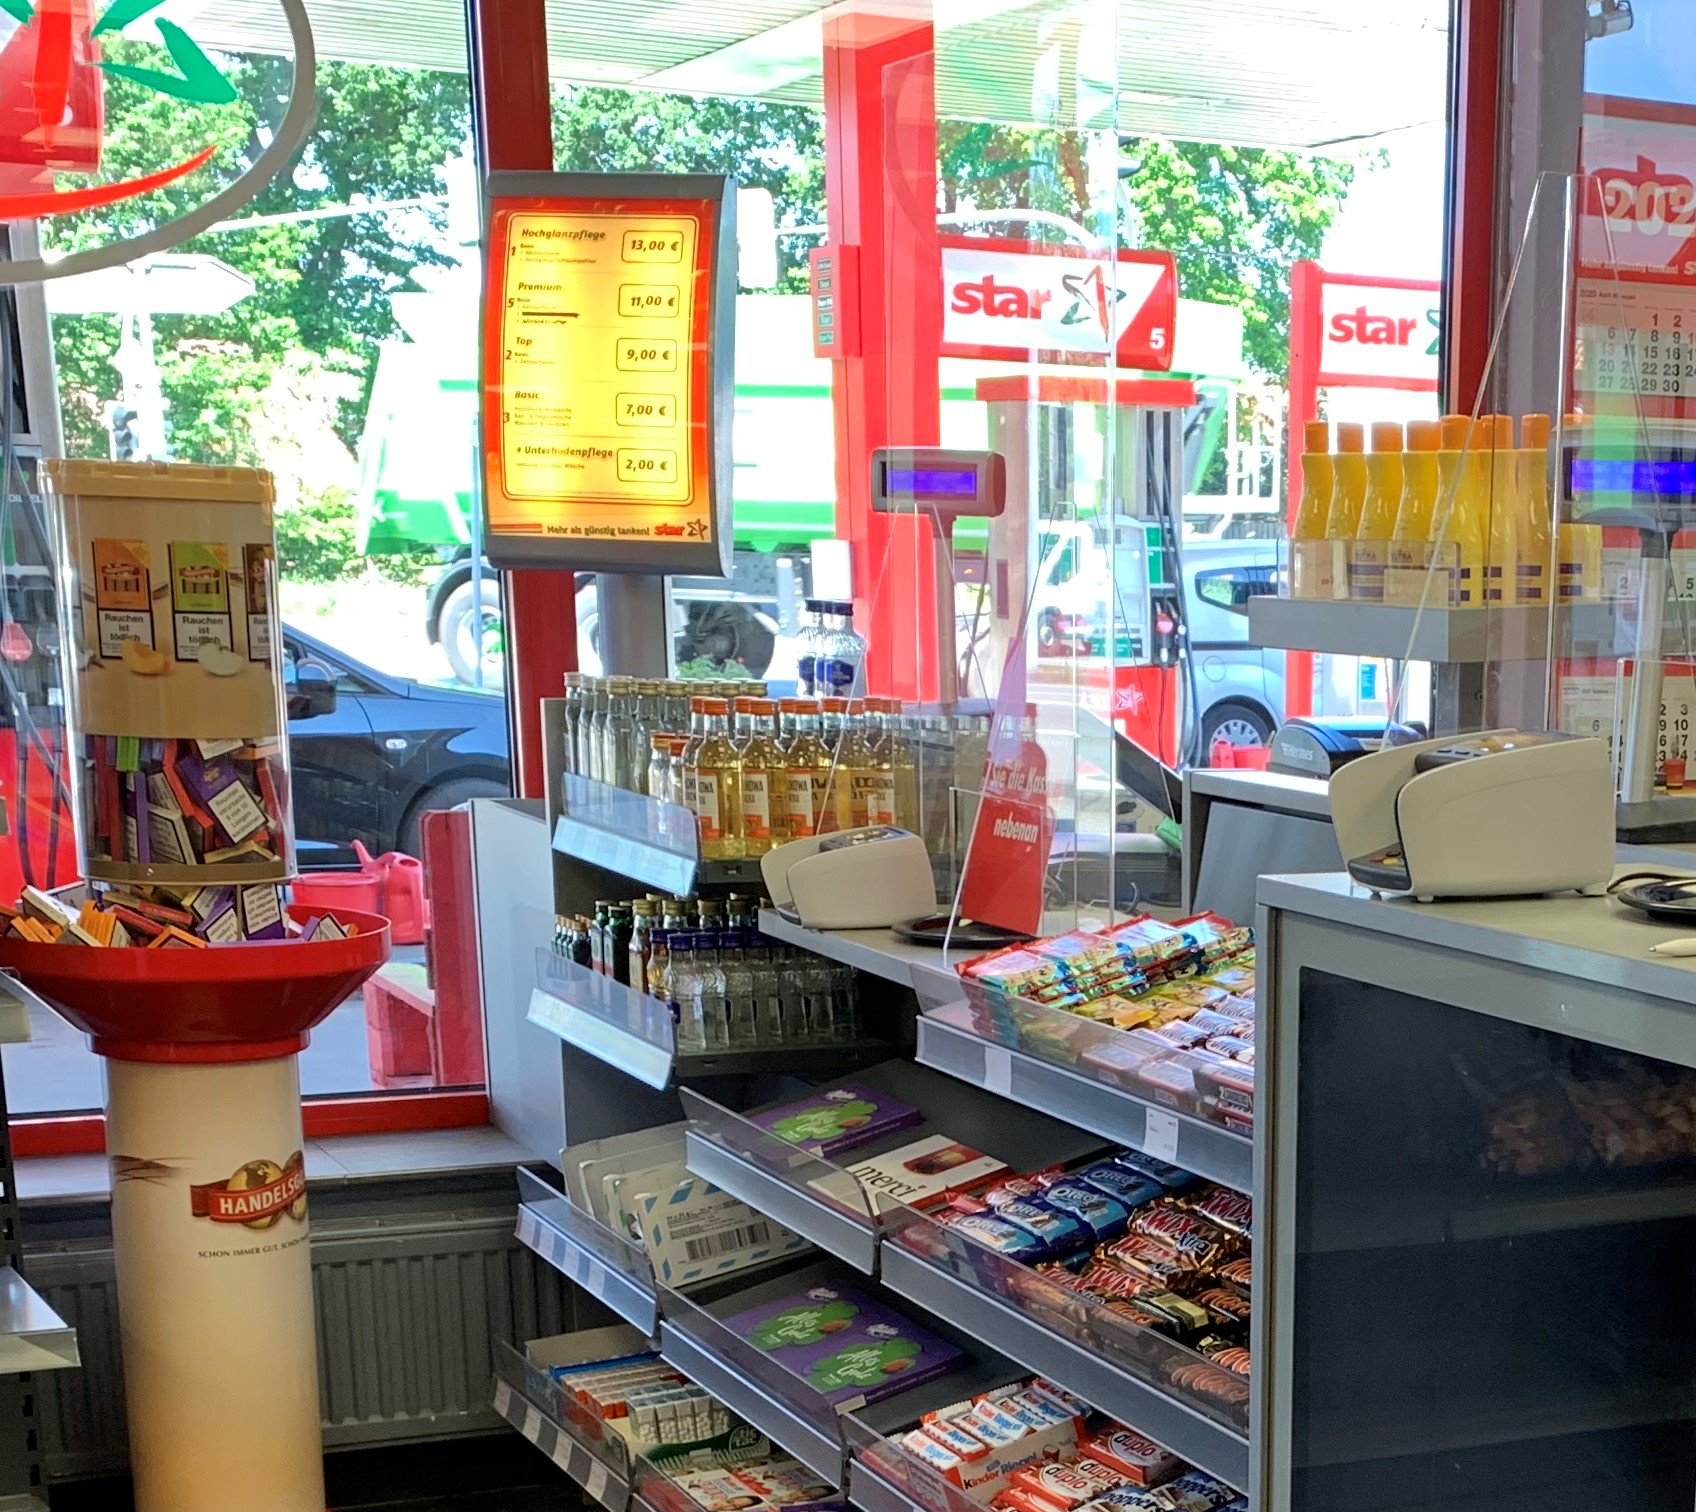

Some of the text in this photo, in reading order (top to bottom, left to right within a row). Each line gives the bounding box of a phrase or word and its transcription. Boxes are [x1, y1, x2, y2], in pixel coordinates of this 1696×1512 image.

[521, 229, 606, 240] Hochglanzpflege
[630, 239, 679, 253] 13,00 €
[518, 282, 563, 292] Premium
[630, 296, 675, 308] 11,00 €
[950, 274, 1053, 320] star
[1328, 306, 1418, 346] star
[515, 336, 533, 347] Top
[1149, 328, 1166, 351] 5
[627, 349, 670, 362] 9,00 €
[514, 390, 540, 400] Basic
[626, 403, 666, 416] 7,00 €
[524, 446, 613, 458] Unterbodenpflege
[625, 459, 668, 472] 2,00 €
[547, 525, 568, 535] Mehr
[570, 525, 582, 535] als
[654, 523, 685, 537] star
[104, 613, 144, 626] Rauchen
[182, 615, 225, 627] Rauchen
[118, 624, 130, 634] ist
[198, 625, 210, 636] ist
[992, 811, 1040, 844] nebenan
[852, 1164, 917, 1199] merci
[1091, 1168, 1137, 1188] OREO
[1144, 1205, 1194, 1238] TWIX
[232, 1247, 261, 1257] IMMER
[1086, 1265, 1143, 1297] TWIX
[963, 1451, 1038, 1491] Kinder Riegel
[1046, 1464, 1088, 1491] duplo
